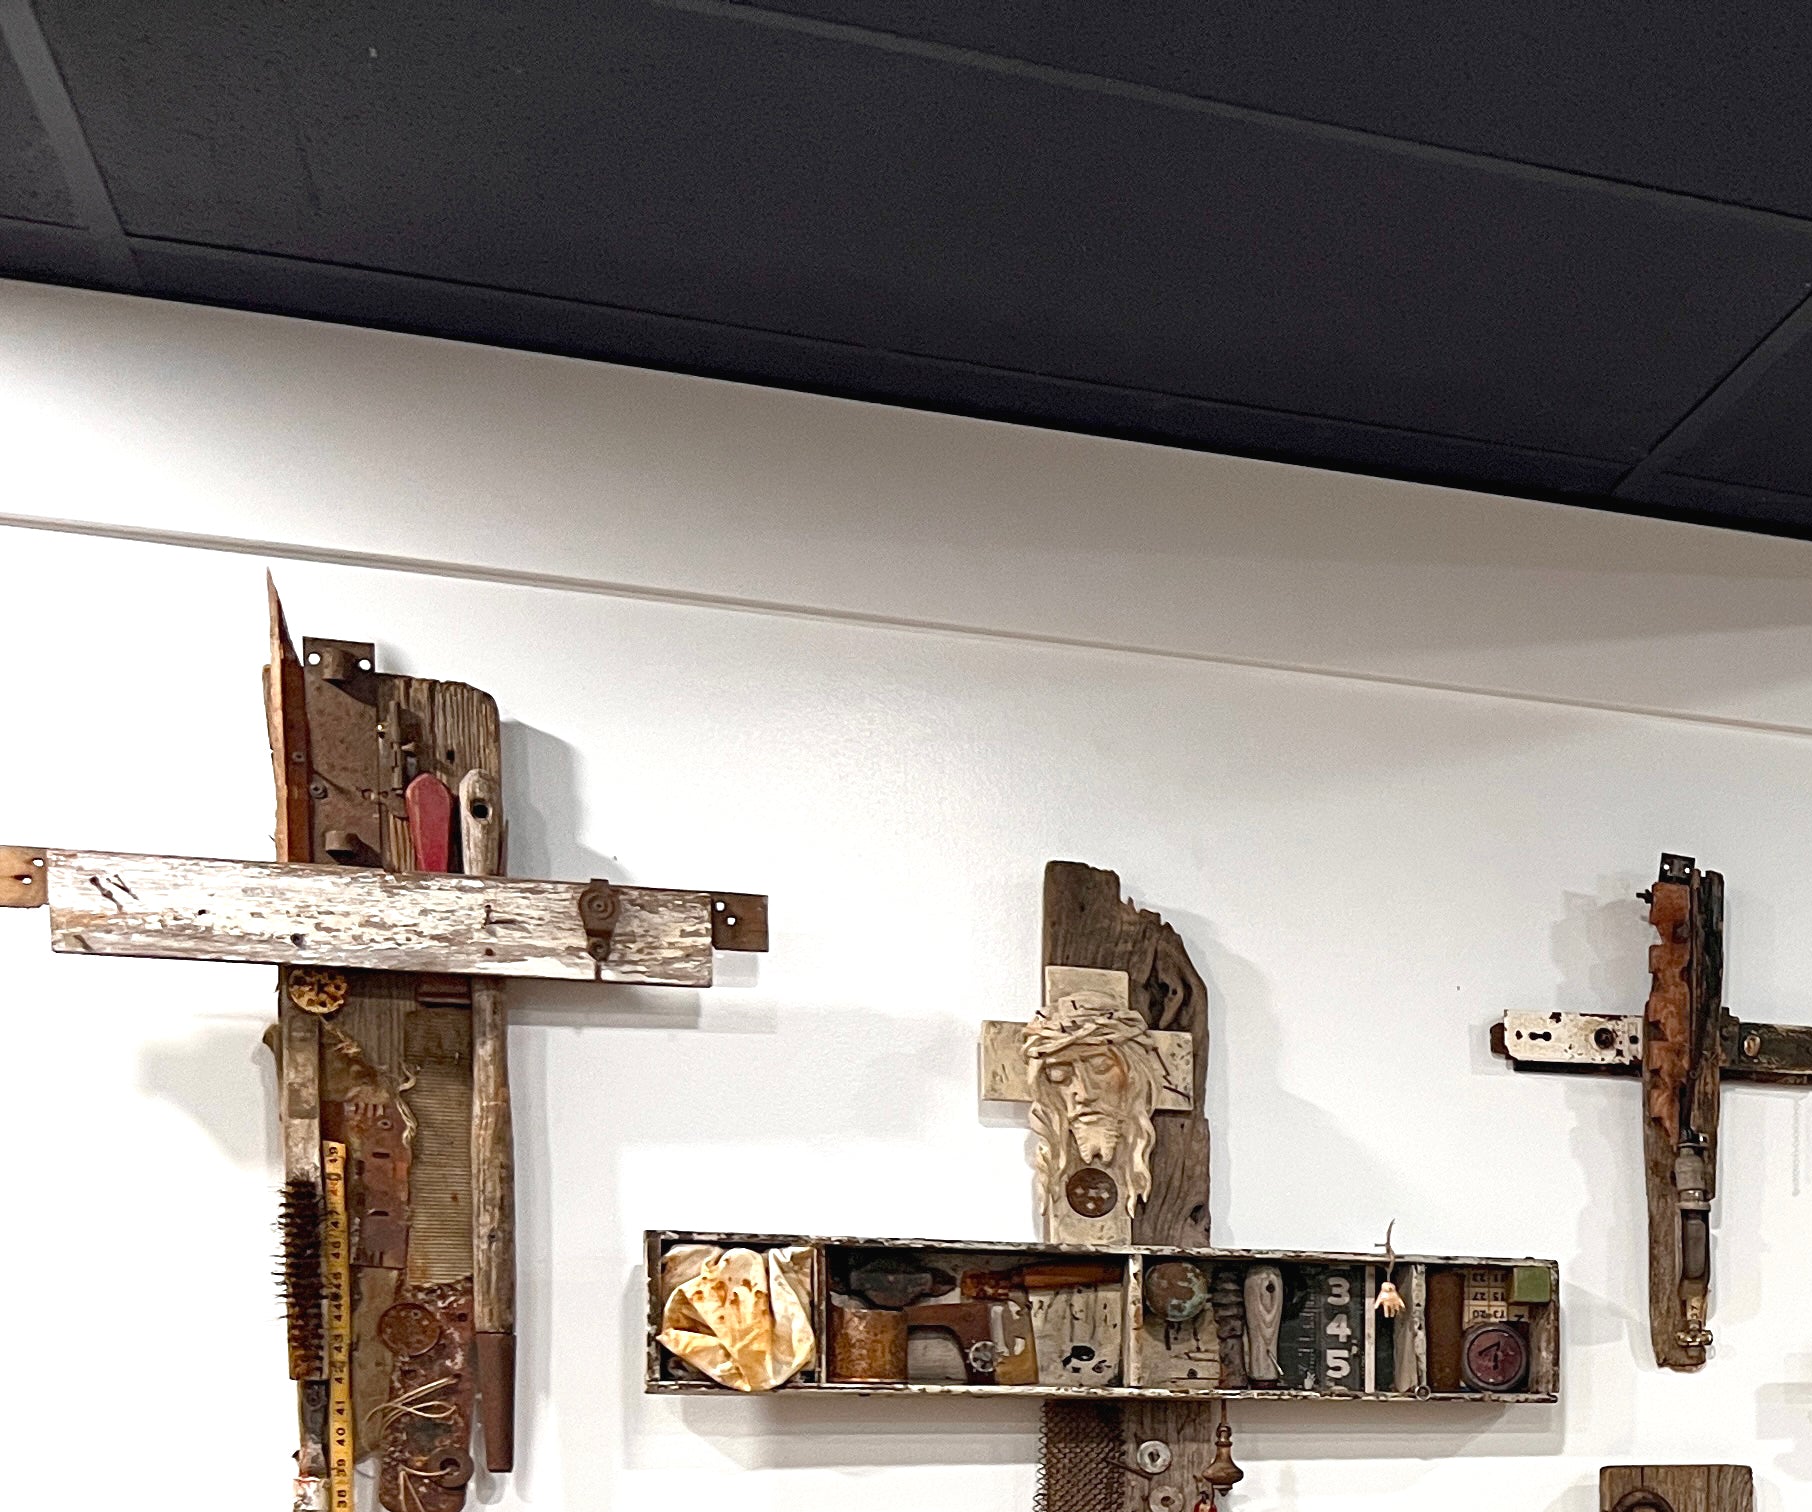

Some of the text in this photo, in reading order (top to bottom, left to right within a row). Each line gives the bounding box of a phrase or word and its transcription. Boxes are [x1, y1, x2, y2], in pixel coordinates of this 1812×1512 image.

[328, 1146, 339, 1164] 49
[331, 1241, 342, 1259] 46
[1326, 1276, 1351, 1306] 3
[1471, 1291, 1487, 1301] 27
[333, 1303, 344, 1322] 44
[1471, 1309, 1487, 1319] 20
[1493, 1309, 1506, 1320] 13
[1325, 1313, 1352, 1342] 4
[333, 1334, 344, 1354] 43
[1325, 1349, 1351, 1379] 5
[335, 1401, 345, 1416] 41
[336, 1427, 346, 1447] 40
[336, 1458, 346, 1477] 39
[337, 1489, 347, 1509] 38
